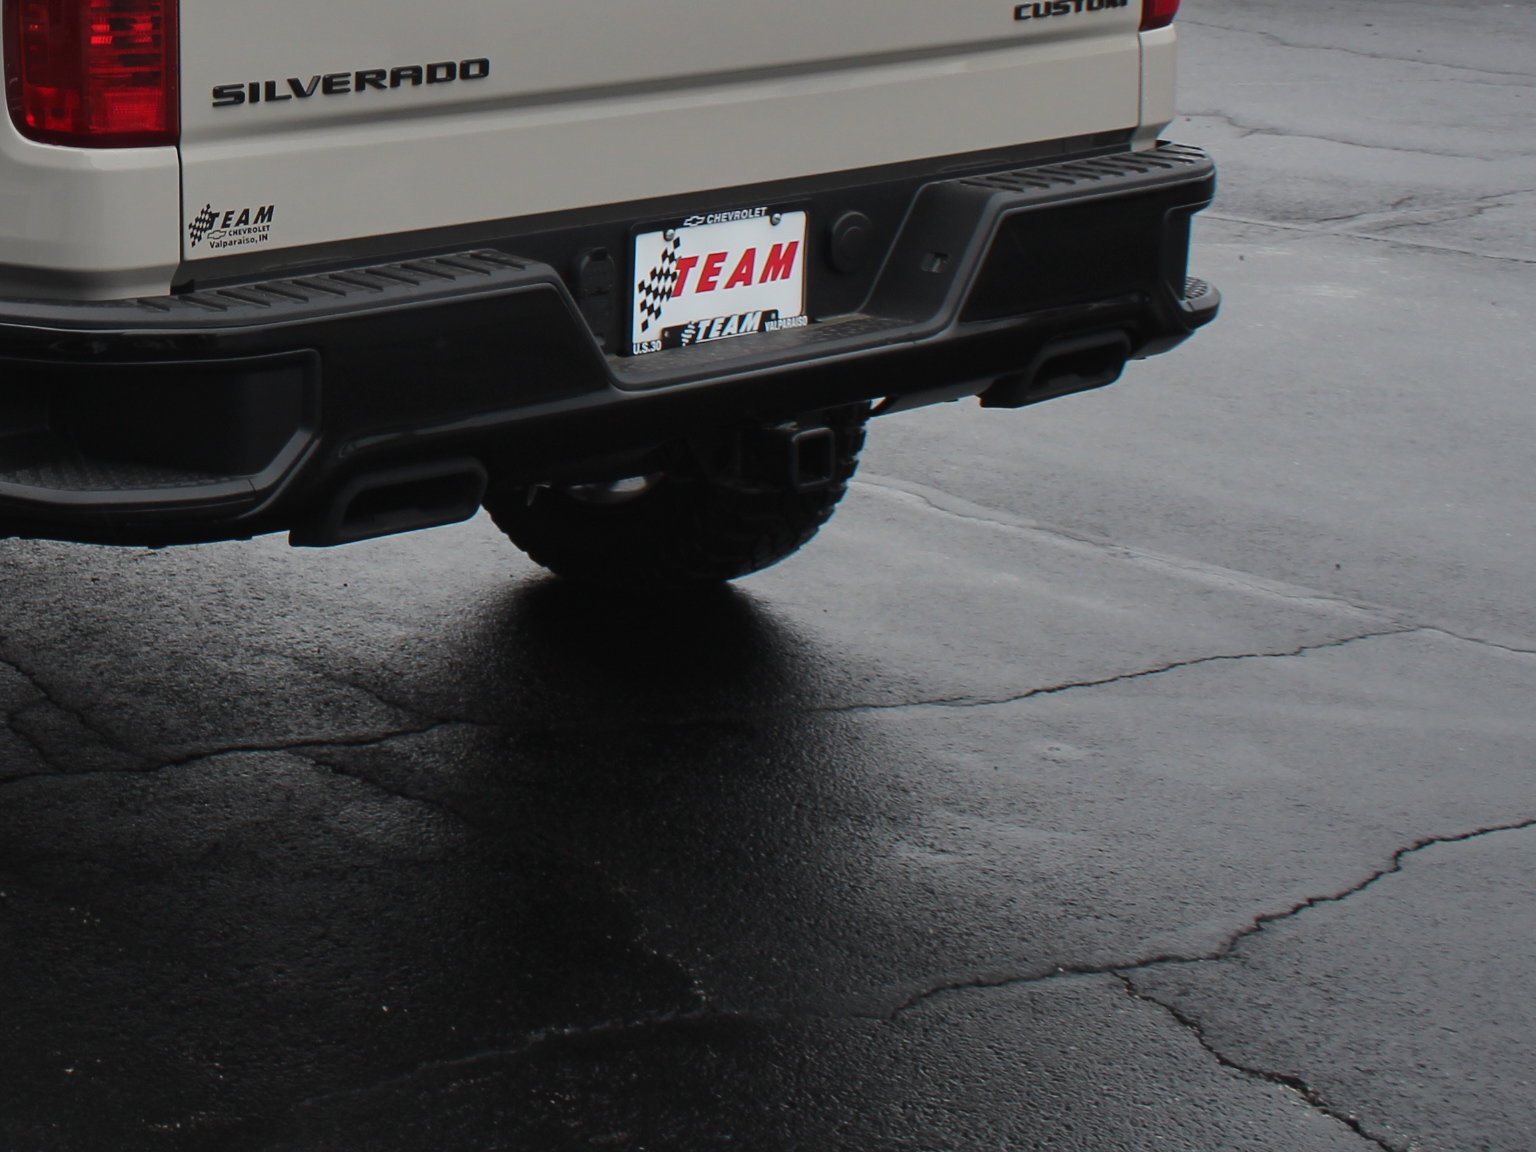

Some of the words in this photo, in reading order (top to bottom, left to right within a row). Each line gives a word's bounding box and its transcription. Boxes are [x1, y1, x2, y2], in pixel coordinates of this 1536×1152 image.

[212, 57, 490, 107] SILVERADO
[207, 205, 275, 230] TEAM
[706, 207, 768, 224] CHEVROLET
[209, 235, 258, 249] Valparaiso,
[259, 233, 268, 242] IN
[228, 224, 270, 237] CHEVROLET
[671, 241, 800, 298] TEAM
[695, 311, 764, 343] TEAM
[764, 315, 809, 332] VALPARAISO
